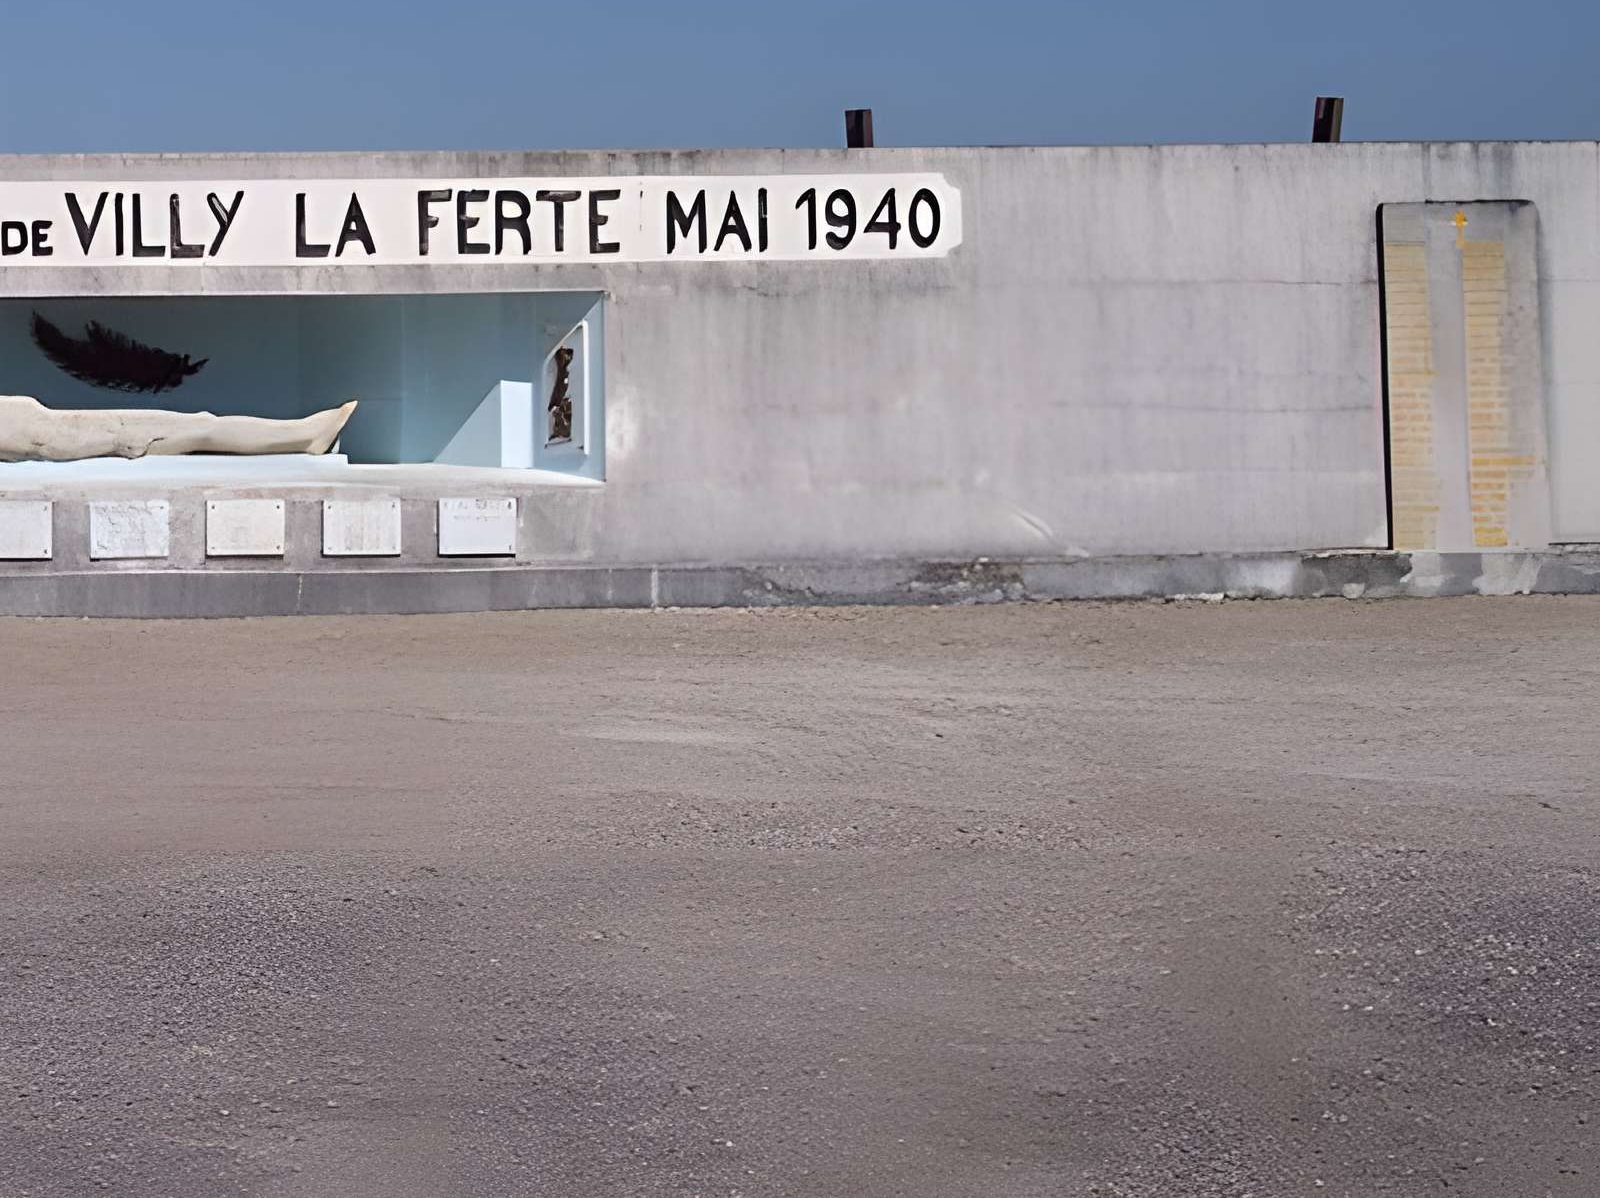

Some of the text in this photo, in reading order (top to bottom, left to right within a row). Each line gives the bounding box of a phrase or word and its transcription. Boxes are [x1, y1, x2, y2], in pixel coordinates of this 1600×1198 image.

[0, 219, 55, 257] DE
[64, 190, 246, 259] VILLY
[294, 191, 377, 258] LA
[417, 188, 622, 256] FERTE
[666, 187, 769, 255] MAI
[794, 186, 942, 251] 1940
